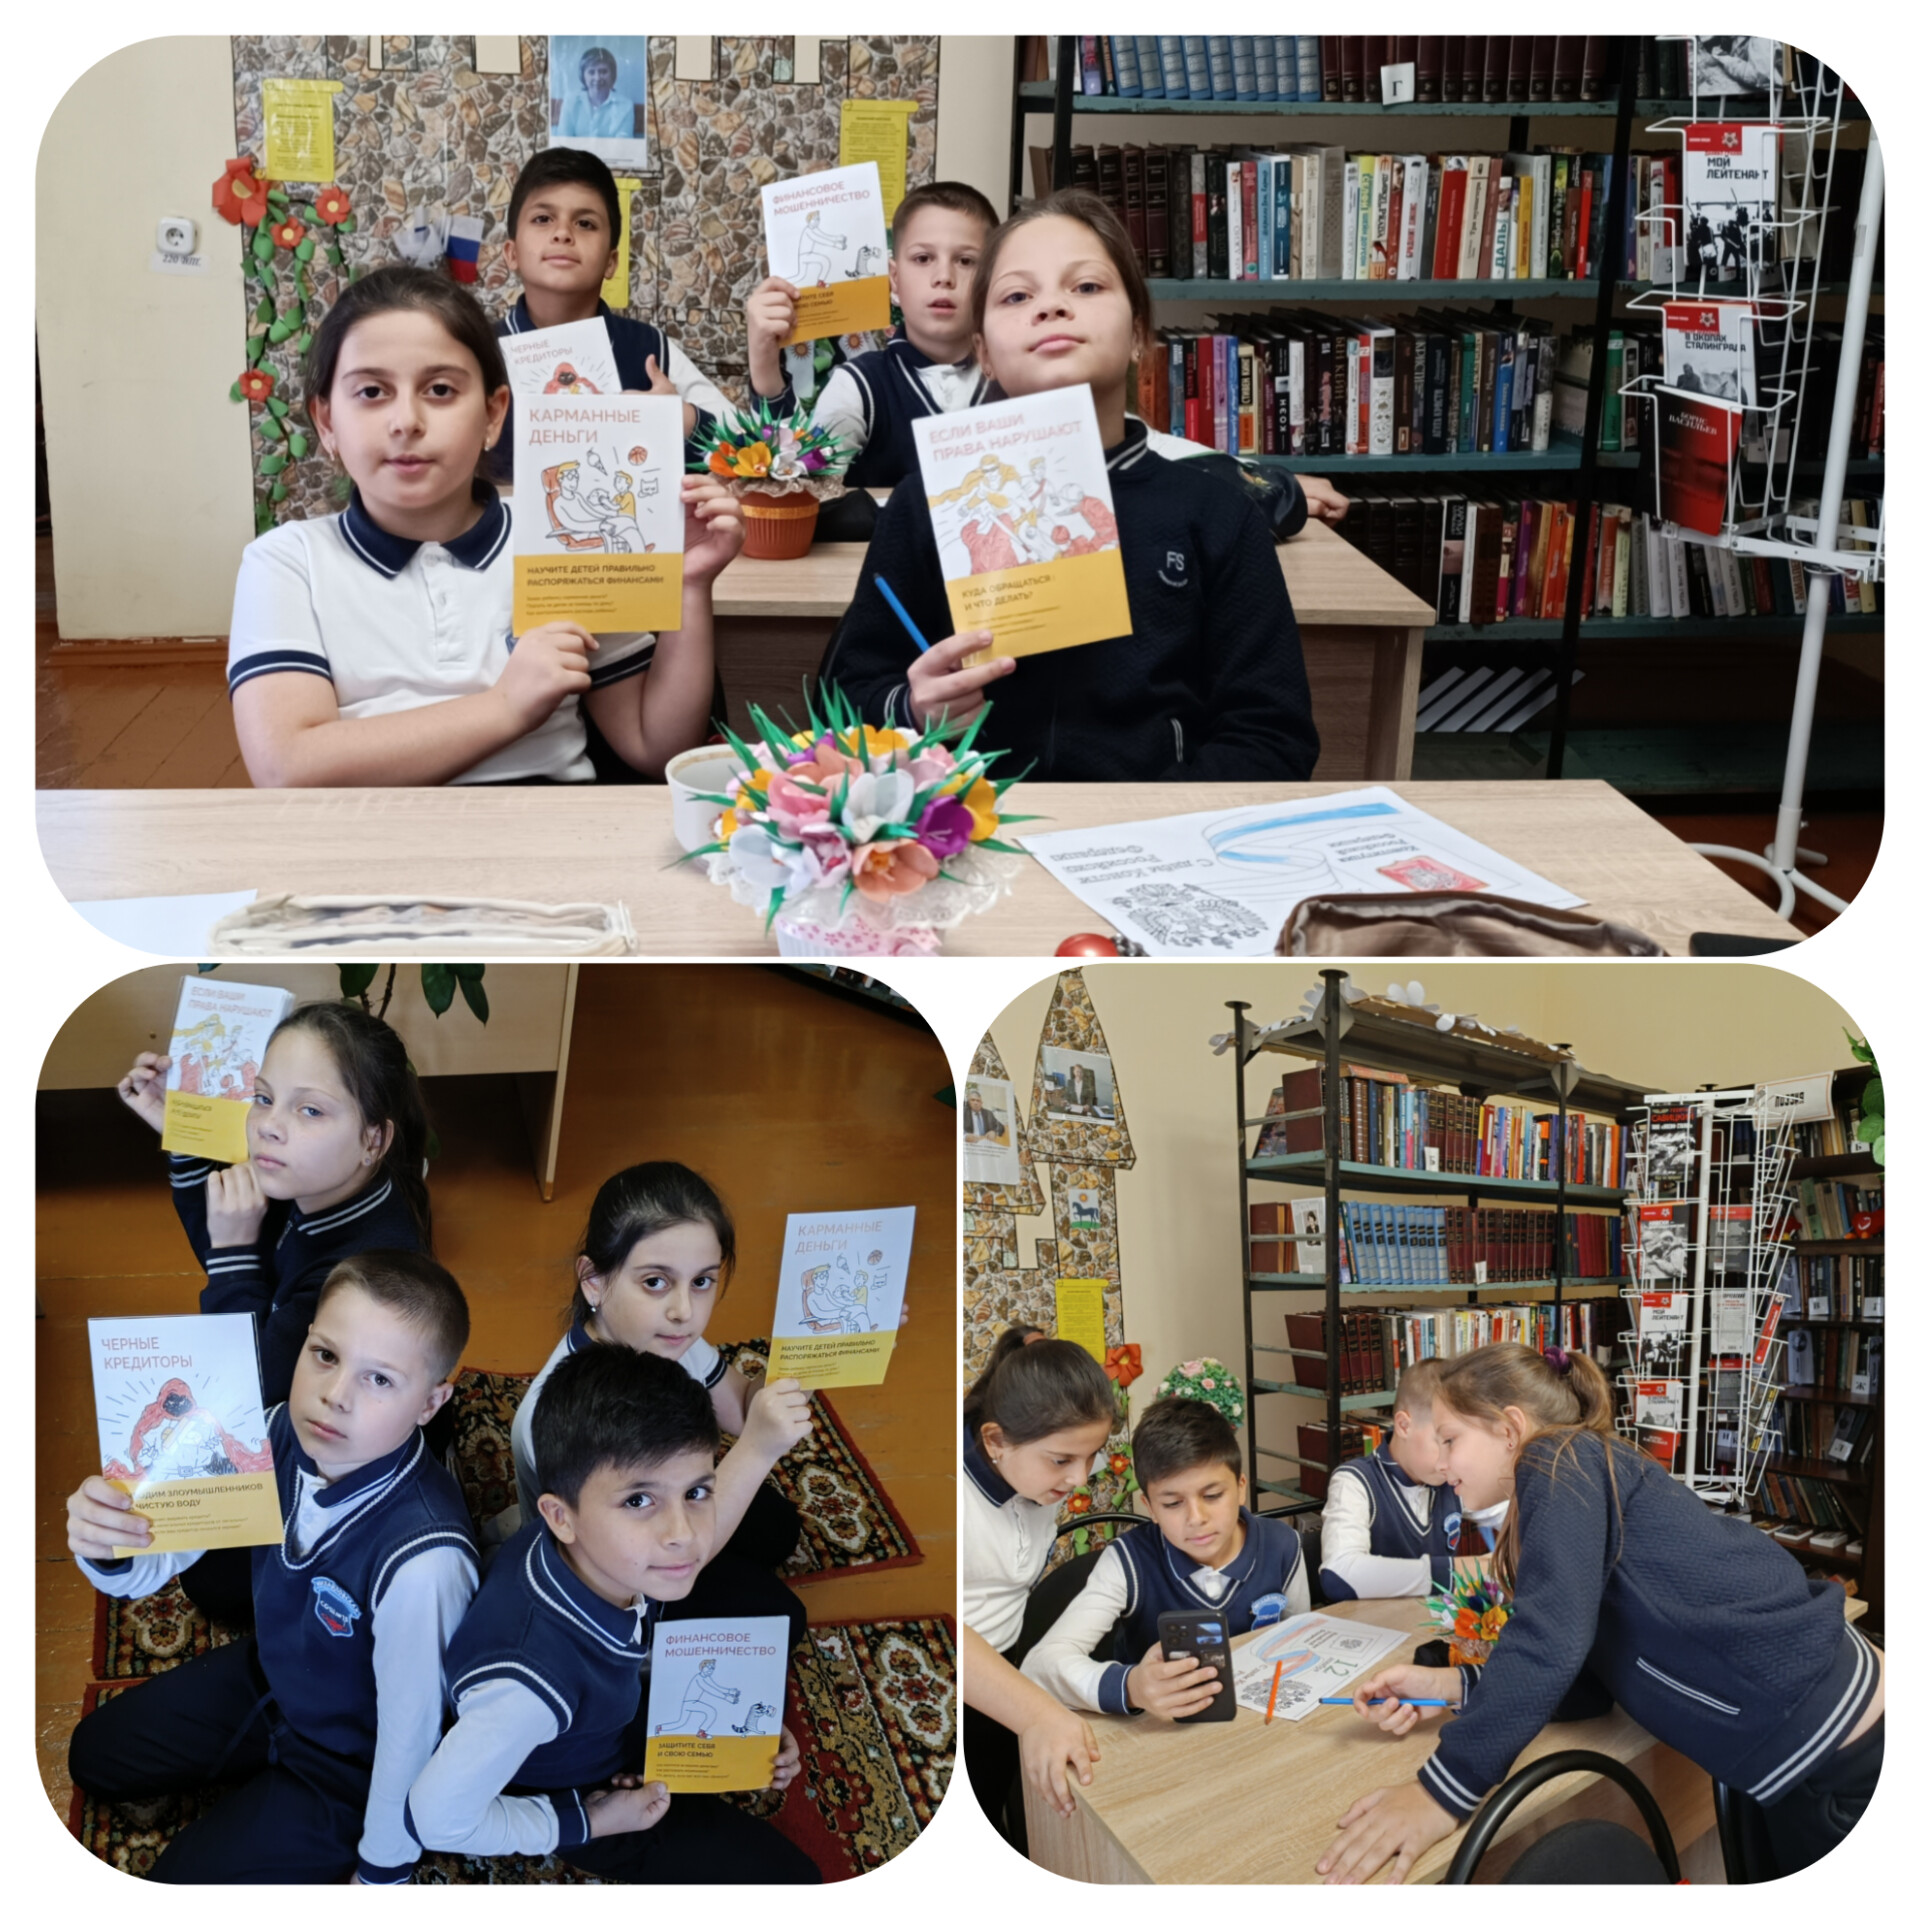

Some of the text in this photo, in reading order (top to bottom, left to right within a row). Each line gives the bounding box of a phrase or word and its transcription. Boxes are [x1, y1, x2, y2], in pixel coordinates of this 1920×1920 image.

[1707, 154, 1730, 168] МОЙ
[772, 181, 845, 205] ФИНАНСОВОЕ
[774, 190, 871, 217] МОШЕННИЧЕСТВО
[1495, 222, 1507, 268] ДАЛЬ
[510, 339, 550, 353] ЧЕРНЫЕ
[514, 347, 573, 366] КРЕДИТОРЫ
[1240, 358, 1250, 404] СТИВЕН КИНГ
[529, 409, 641, 423] КАРМАННЫЕ
[1279, 398, 1287, 432] КОЭН
[930, 413, 1025, 444] ЕСЛИ ВАШИ
[1669, 414, 1718, 436] ВАСИЛЬЕВ
[529, 429, 598, 446] ДЕНЬГИ
[932, 420, 1083, 462] ПРАВА НАРУШАЮТ
[527, 564, 655, 574] НАУЧИТЕ ДЕТЕЙ ПРАВИЛЬНО
[1166, 551, 1185, 571] FS
[527, 576, 664, 587] РАСПОРЯЖАТЬСЯ ФИНАНСАМИ
[962, 575, 1051, 599] КУДА ОБРАЩАТЬСЯ
[964, 591, 1034, 611] И ЧТО ДЕЛАТЬ?
[798, 1221, 883, 1237] КАРМАННЫЕ
[795, 1240, 847, 1255] ДЕНЬГИ
[102, 1337, 160, 1350] ЧЕРНЫЕ
[814, 1342, 836, 1350] ДЕТЕЙ
[837, 1340, 876, 1348] ПРАВИЛЬНО
[104, 1355, 193, 1371] КРЕДИТОРЫ
[780, 1352, 837, 1361] РАСПОРЯЖАТЬСЯ
[168, 1483, 264, 1496] ЗЛОУМЫШЛЕННИКОВ
[136, 1499, 201, 1510] ЧИСТУЮ ВОДУ
[665, 1633, 751, 1645] ФИНАНСОВОЕ
[665, 1646, 776, 1658] МОШЕННИЧЕСТВО
